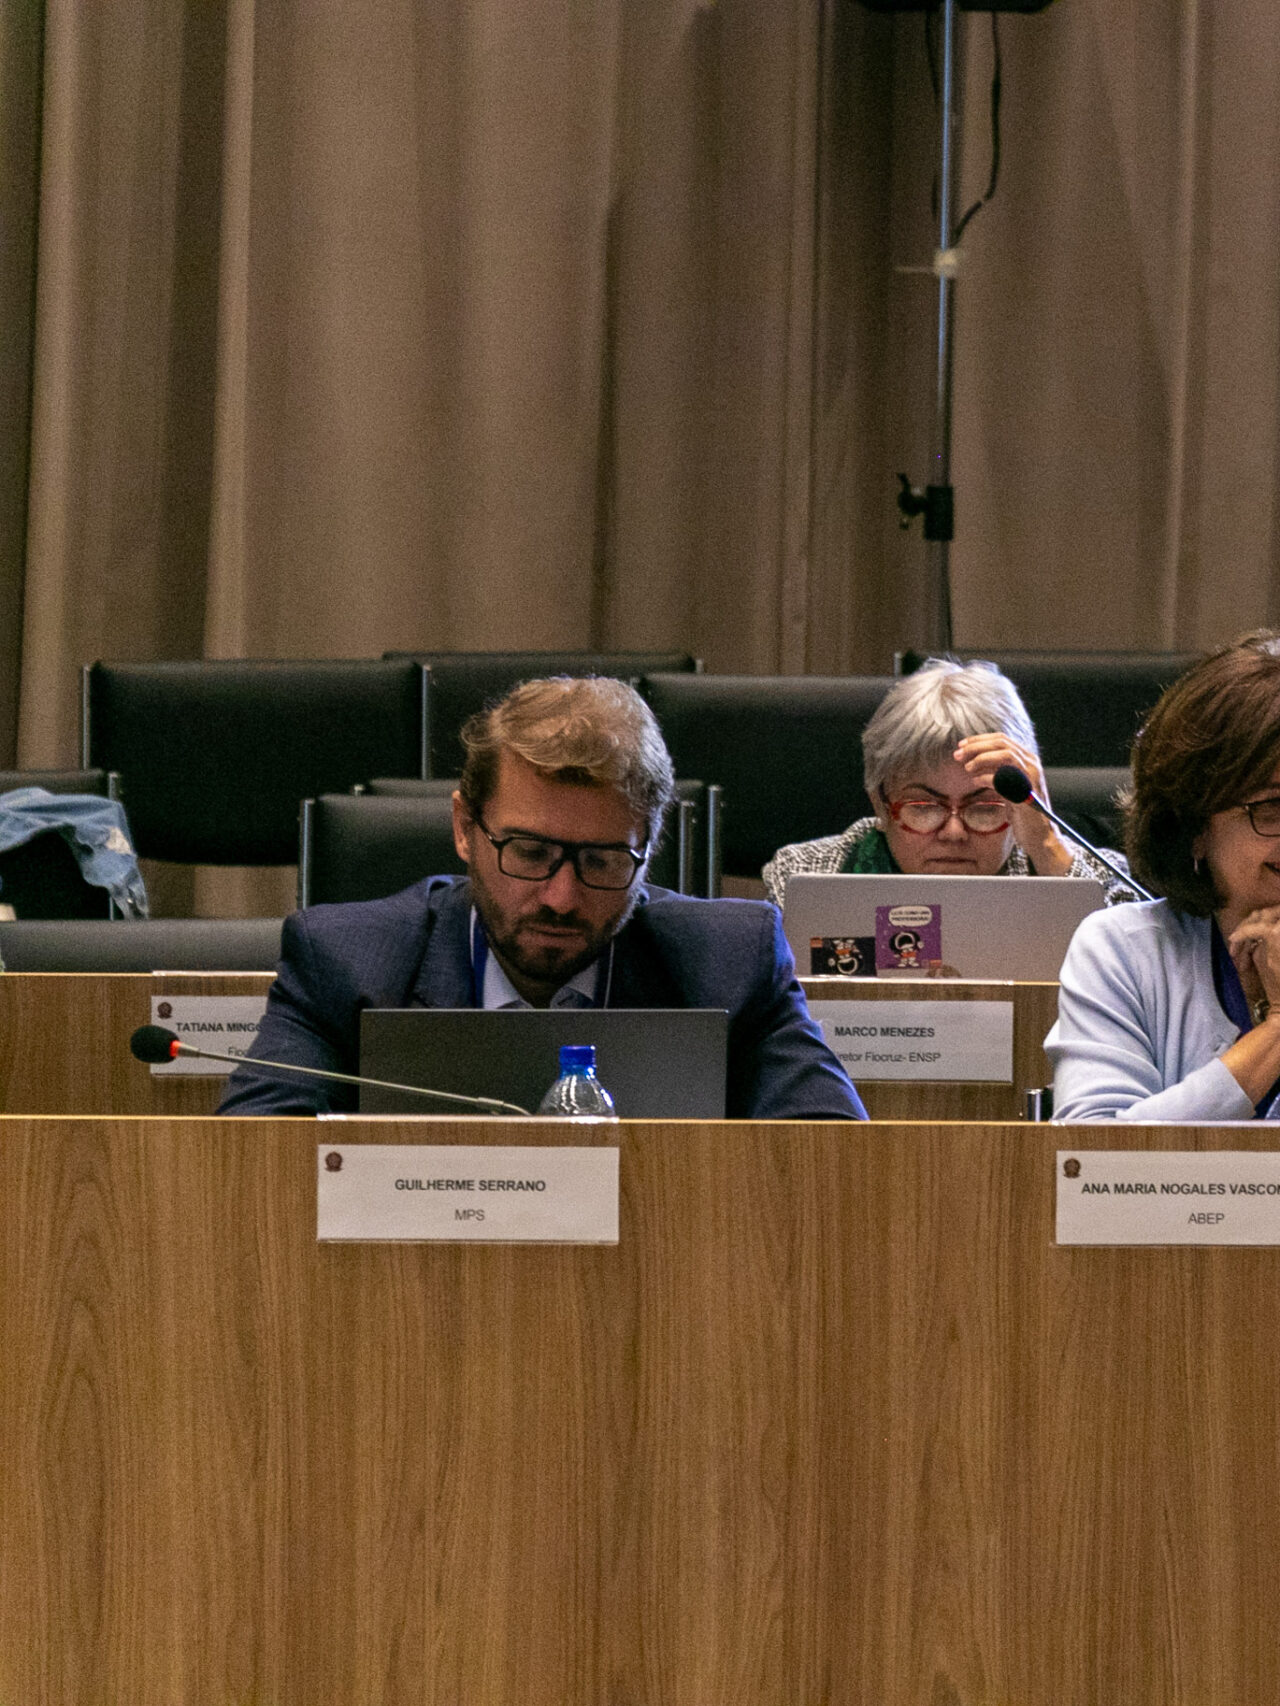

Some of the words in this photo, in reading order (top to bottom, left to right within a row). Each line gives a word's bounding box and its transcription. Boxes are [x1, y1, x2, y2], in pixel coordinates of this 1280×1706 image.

[176, 1022, 224, 1033] TATIANA
[834, 1026, 878, 1038] MARCO
[880, 1027, 936, 1039] MENEZES
[908, 1052, 942, 1064] ENSP
[394, 1179, 475, 1192] GUILHERME
[478, 1179, 547, 1192] SERRANO
[1081, 1183, 1111, 1195] ANA
[1113, 1183, 1158, 1195] MARIA
[1160, 1183, 1226, 1196] NOGALES
[454, 1209, 486, 1222] MPS
[1187, 1212, 1225, 1225] ABEP
